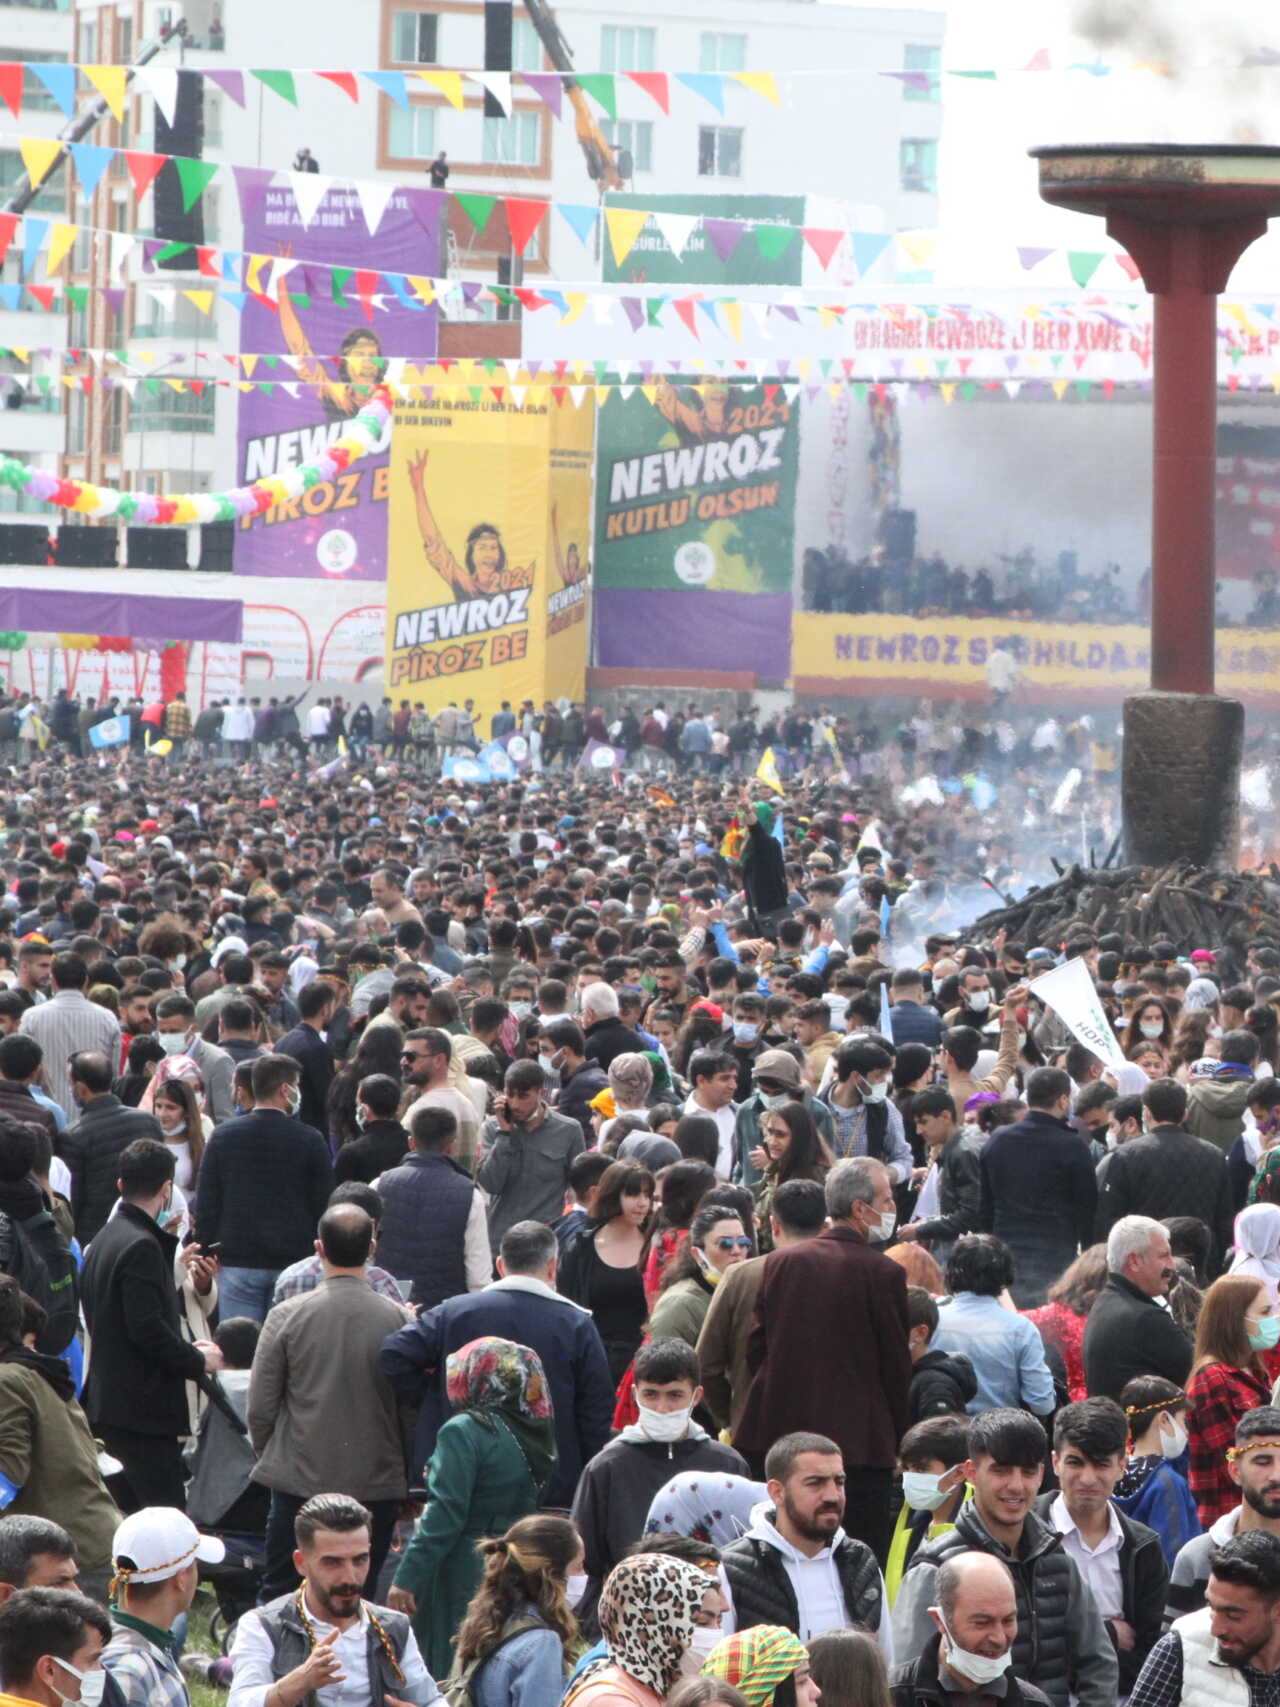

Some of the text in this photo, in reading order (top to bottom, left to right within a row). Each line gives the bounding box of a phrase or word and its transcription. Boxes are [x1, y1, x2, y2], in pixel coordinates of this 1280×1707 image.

[610, 427, 785, 503] NEWROZ
[606, 481, 780, 539] KUTLU OLSUN
[394, 588, 530, 648] NEWROZ
[490, 631, 528, 665] BE
